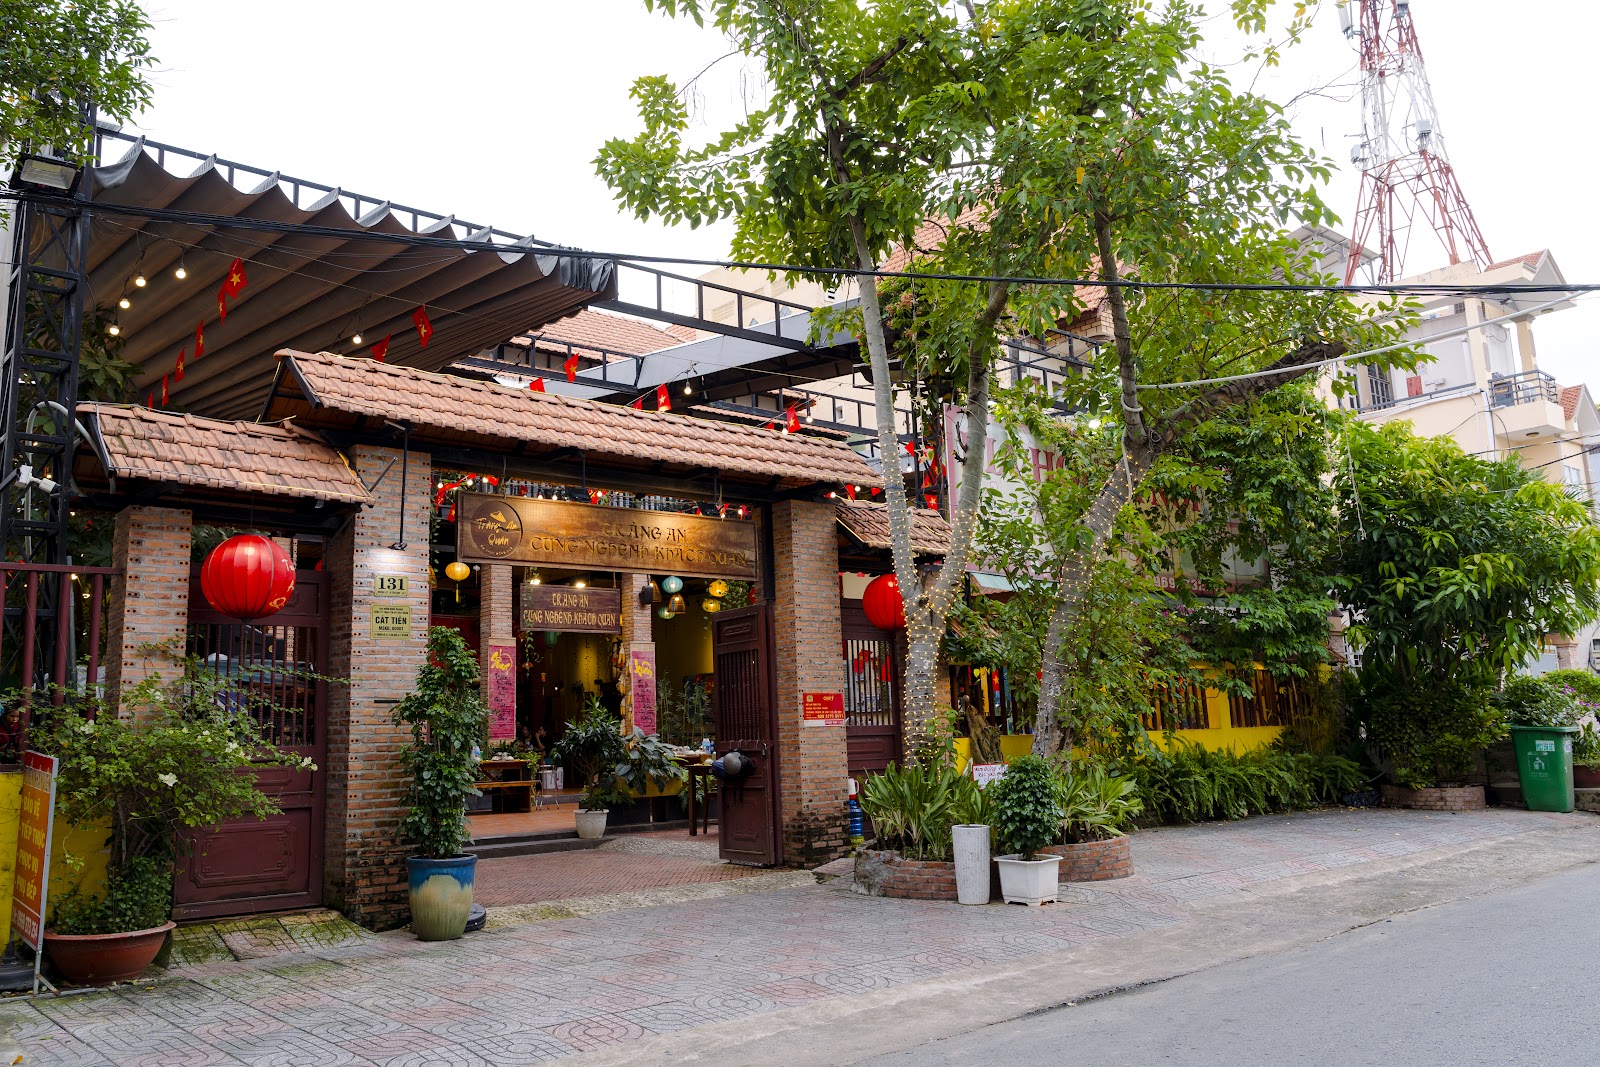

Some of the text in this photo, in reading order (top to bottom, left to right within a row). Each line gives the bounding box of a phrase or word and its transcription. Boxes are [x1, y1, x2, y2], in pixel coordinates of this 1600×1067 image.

[666, 527, 687, 543] AN
[378, 577, 405, 591] 131
[578, 594, 589, 608] AN
